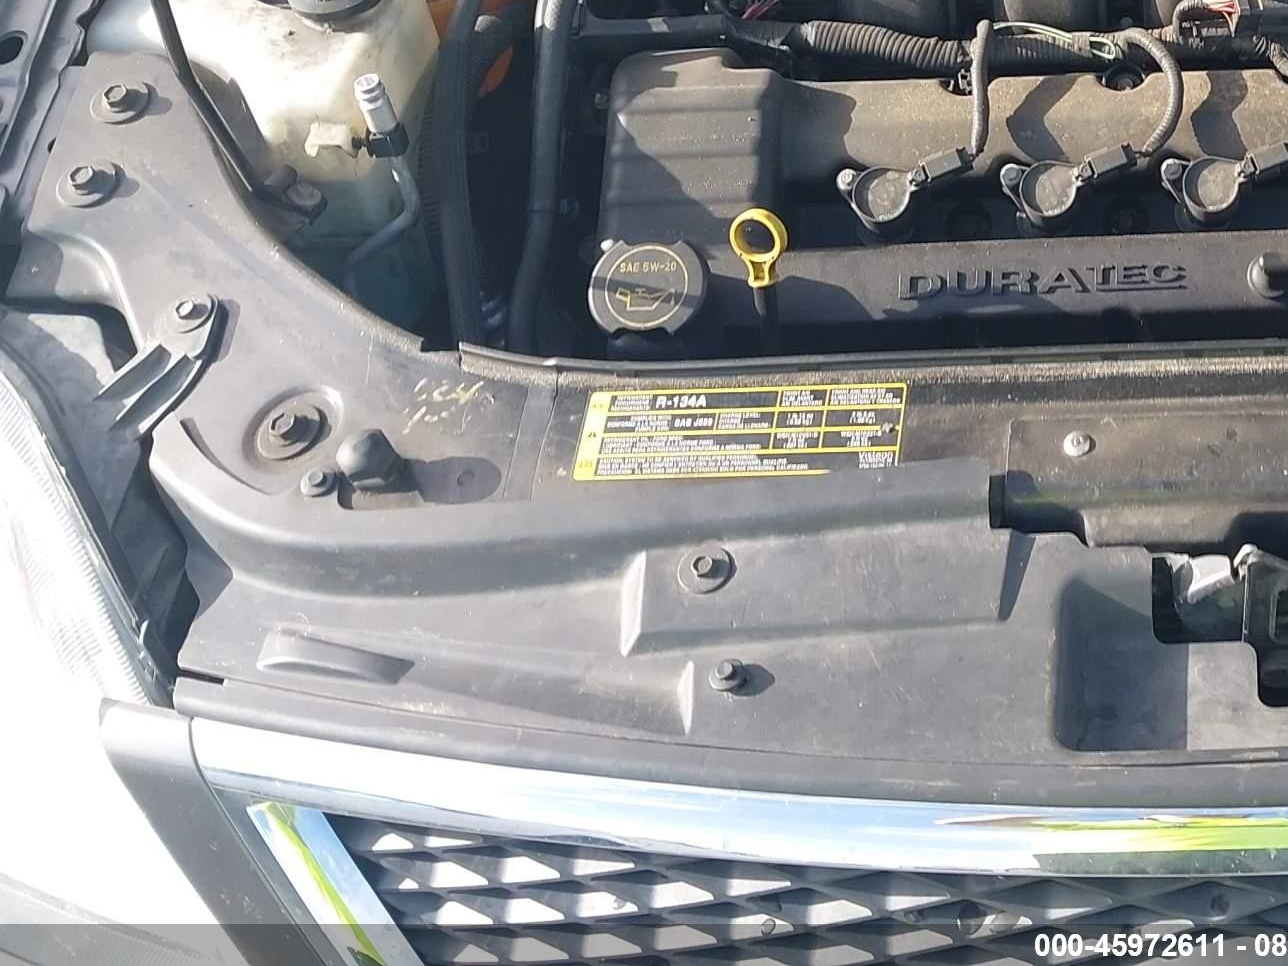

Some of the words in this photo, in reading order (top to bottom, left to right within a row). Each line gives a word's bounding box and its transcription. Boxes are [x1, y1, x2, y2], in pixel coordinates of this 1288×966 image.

[619, 261, 640, 273] SAE
[642, 260, 678, 273] 5W-20
[898, 263, 1188, 301] DURATEC
[655, 394, 707, 409] R-134A
